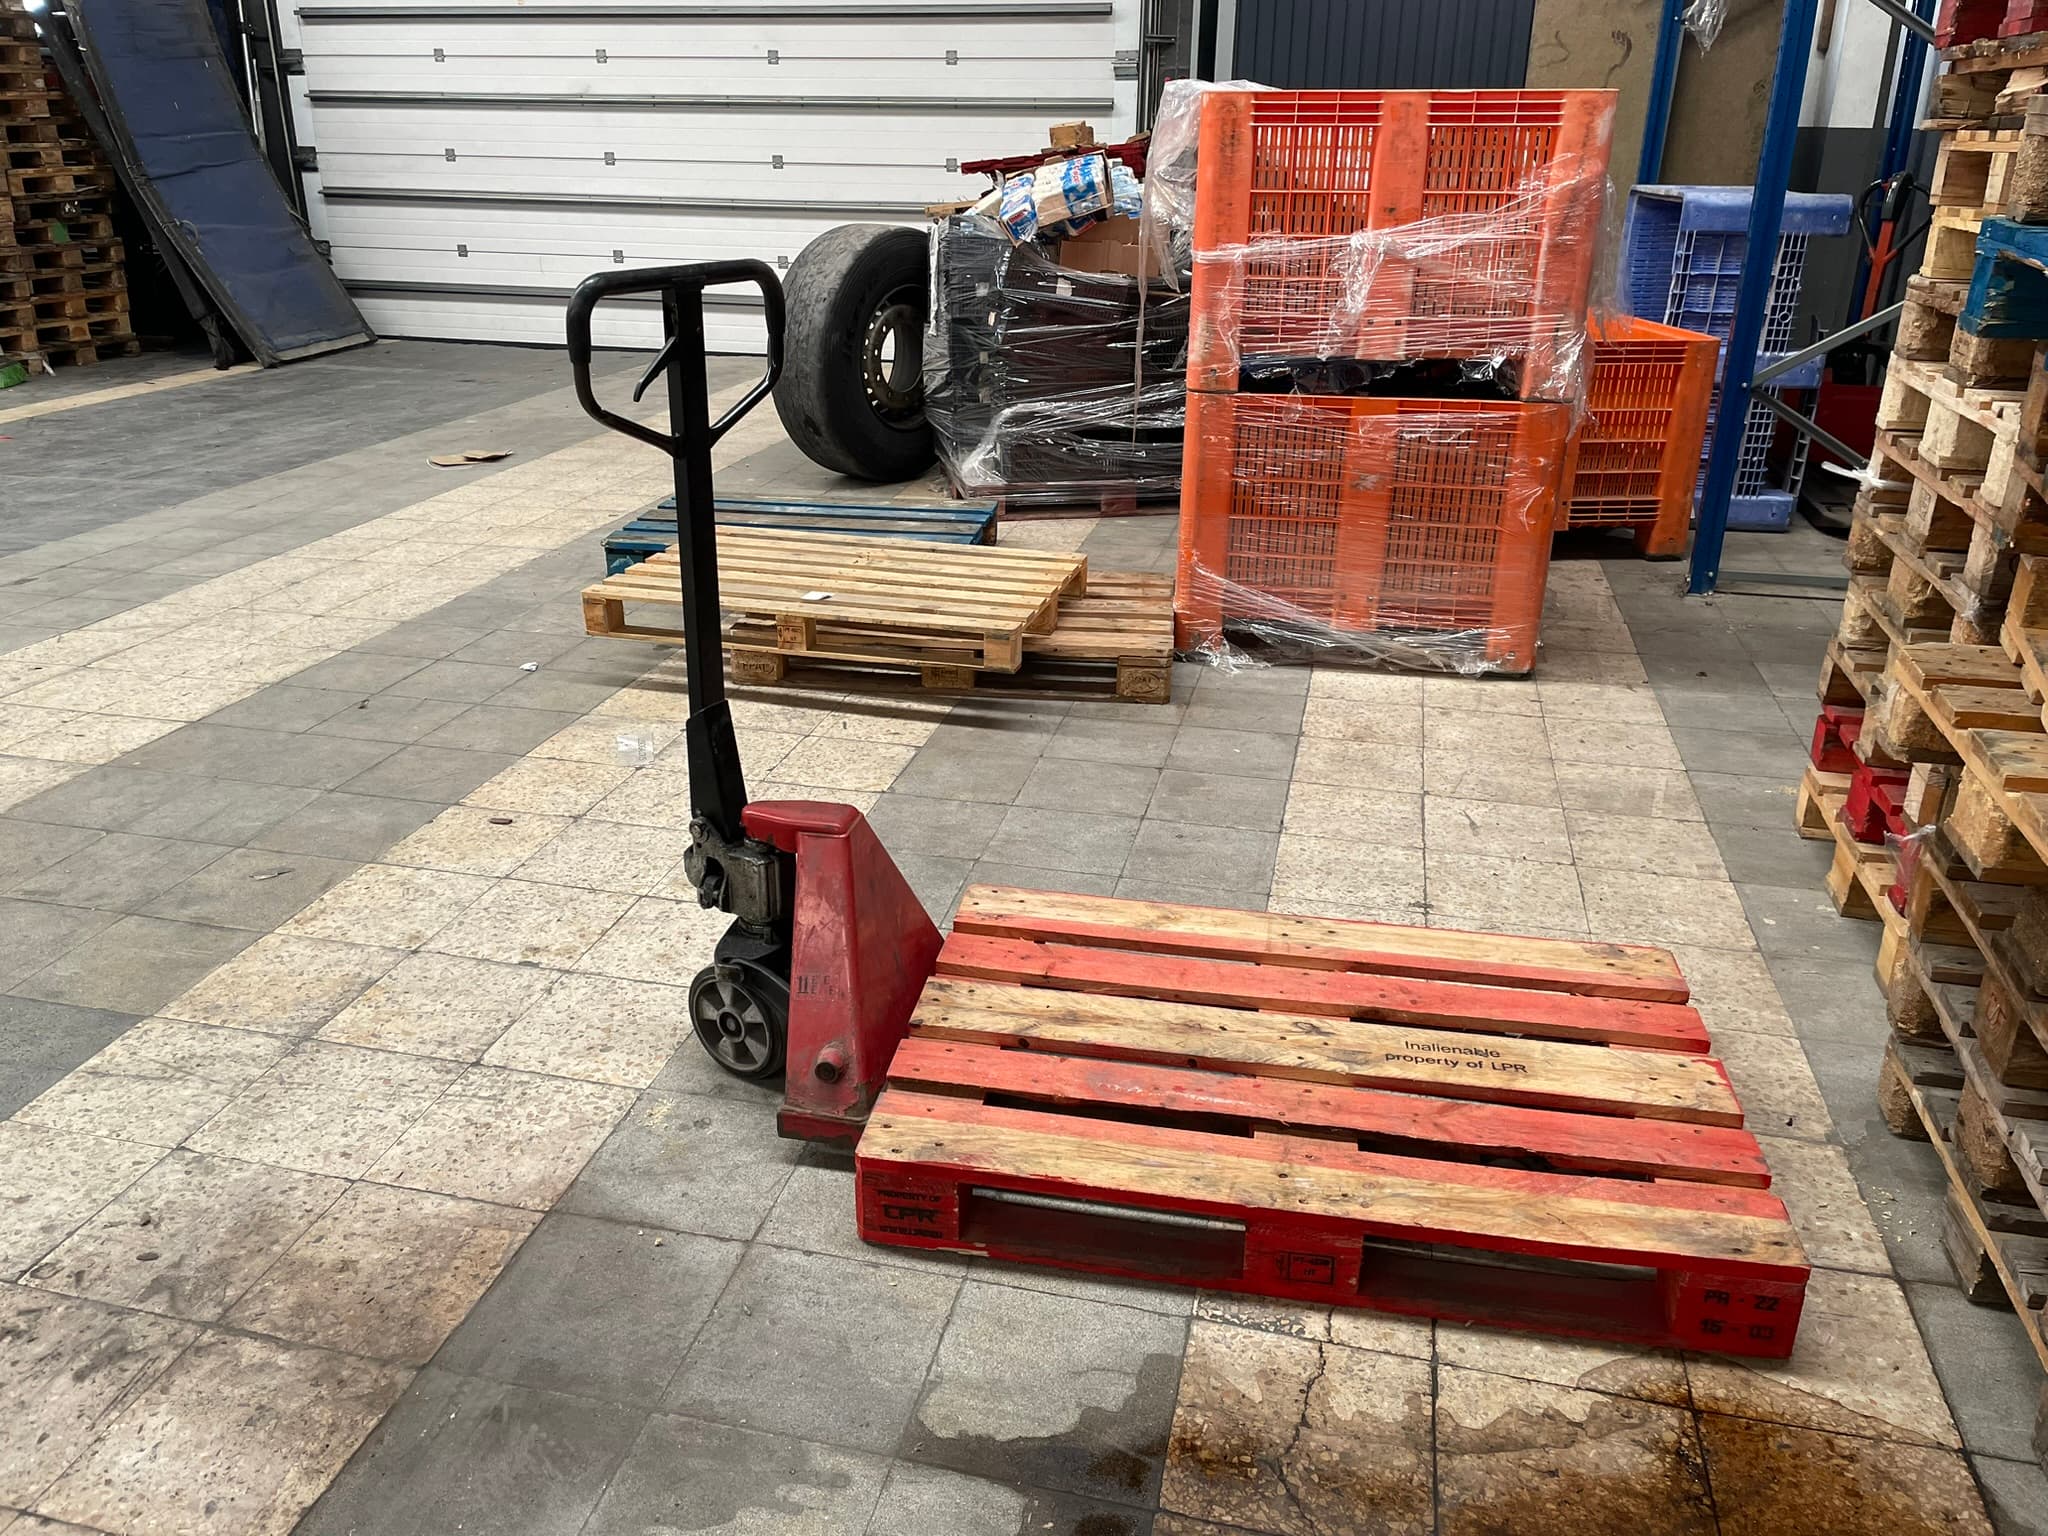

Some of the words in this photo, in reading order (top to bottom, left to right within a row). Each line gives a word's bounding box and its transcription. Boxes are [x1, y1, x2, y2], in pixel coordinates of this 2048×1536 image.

[1404, 1040, 1501, 1058] Inalienable
[1385, 1052, 1460, 1068] property
[1467, 1060, 1484, 1069] of
[1491, 1061, 1529, 1073] LPR
[1753, 1294, 1779, 1312] 22
